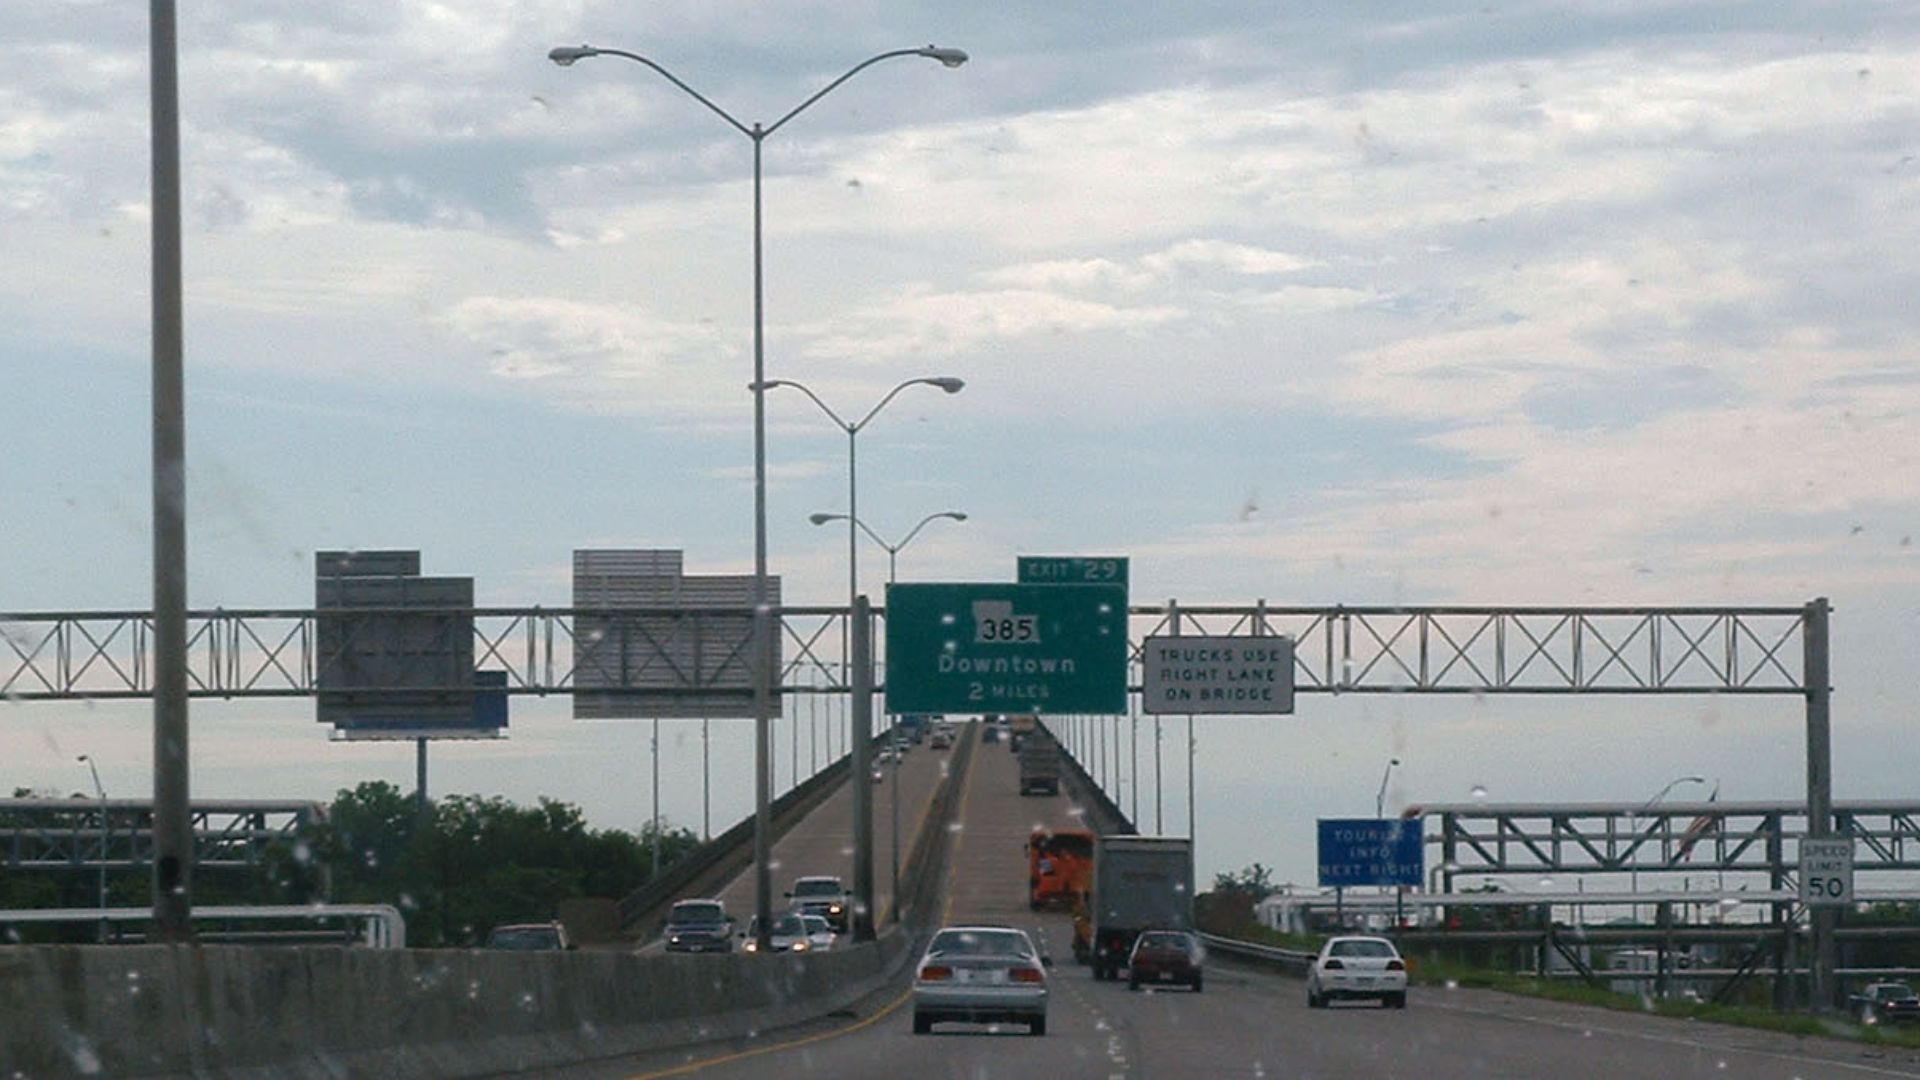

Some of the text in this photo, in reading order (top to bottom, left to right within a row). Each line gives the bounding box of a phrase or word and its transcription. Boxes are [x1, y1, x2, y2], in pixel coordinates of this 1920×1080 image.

[1026, 561, 1118, 579] EXIT 29
[982, 618, 1033, 641] 385
[1159, 649, 1280, 663] TRUCKS USE
[938, 655, 1076, 674] Downtown
[1160, 668, 1275, 682] RIGHT LANE
[968, 683, 1050, 701] 2 MILES
[1165, 687, 1273, 701] ON BRIDGE
[1804, 845, 1849, 857] SPEED
[1319, 864, 1421, 876] NEXT RIGHT
[1808, 861, 1842, 872] LIMIT
[1809, 877, 1844, 898] 50
